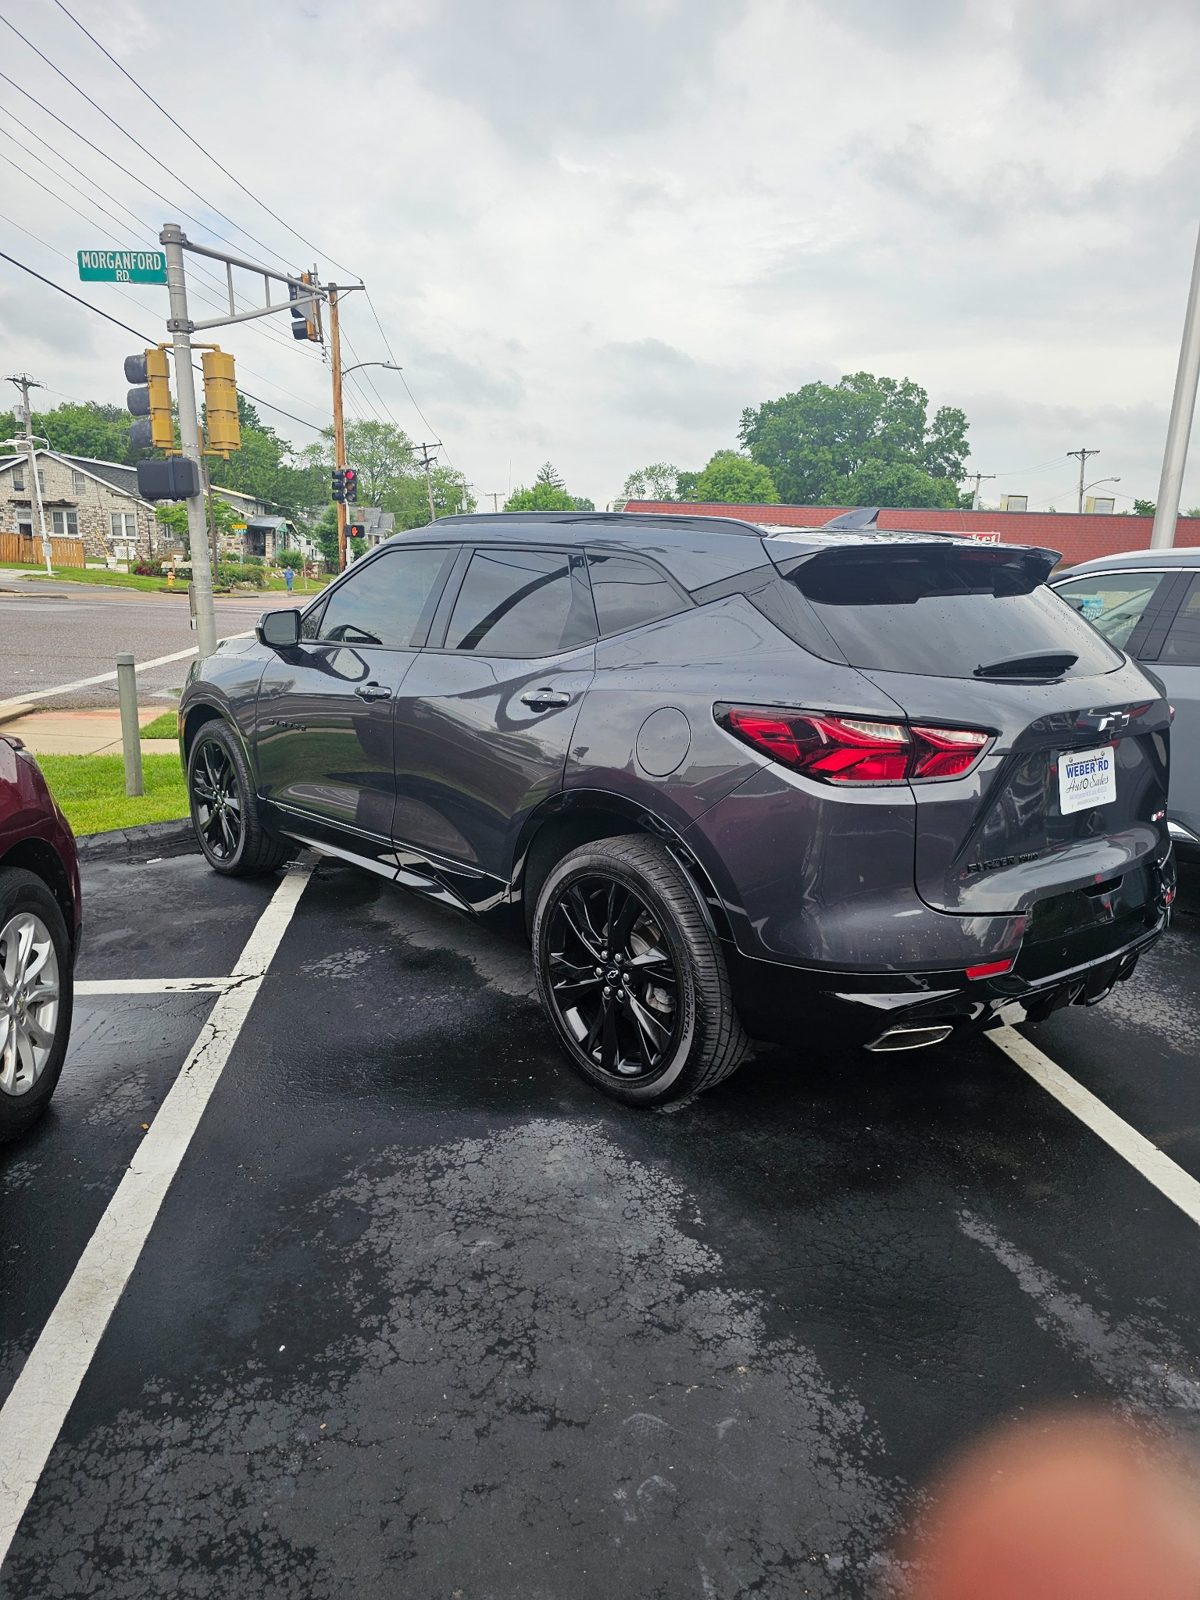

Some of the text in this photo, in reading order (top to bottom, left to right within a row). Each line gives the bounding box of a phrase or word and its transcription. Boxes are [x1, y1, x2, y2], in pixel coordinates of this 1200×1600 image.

[81, 251, 162, 270] MORGANFORD
[116, 270, 130, 281] RD
[1065, 759, 1109, 779] WEBER RD
[1089, 773, 1109, 788] Sales
